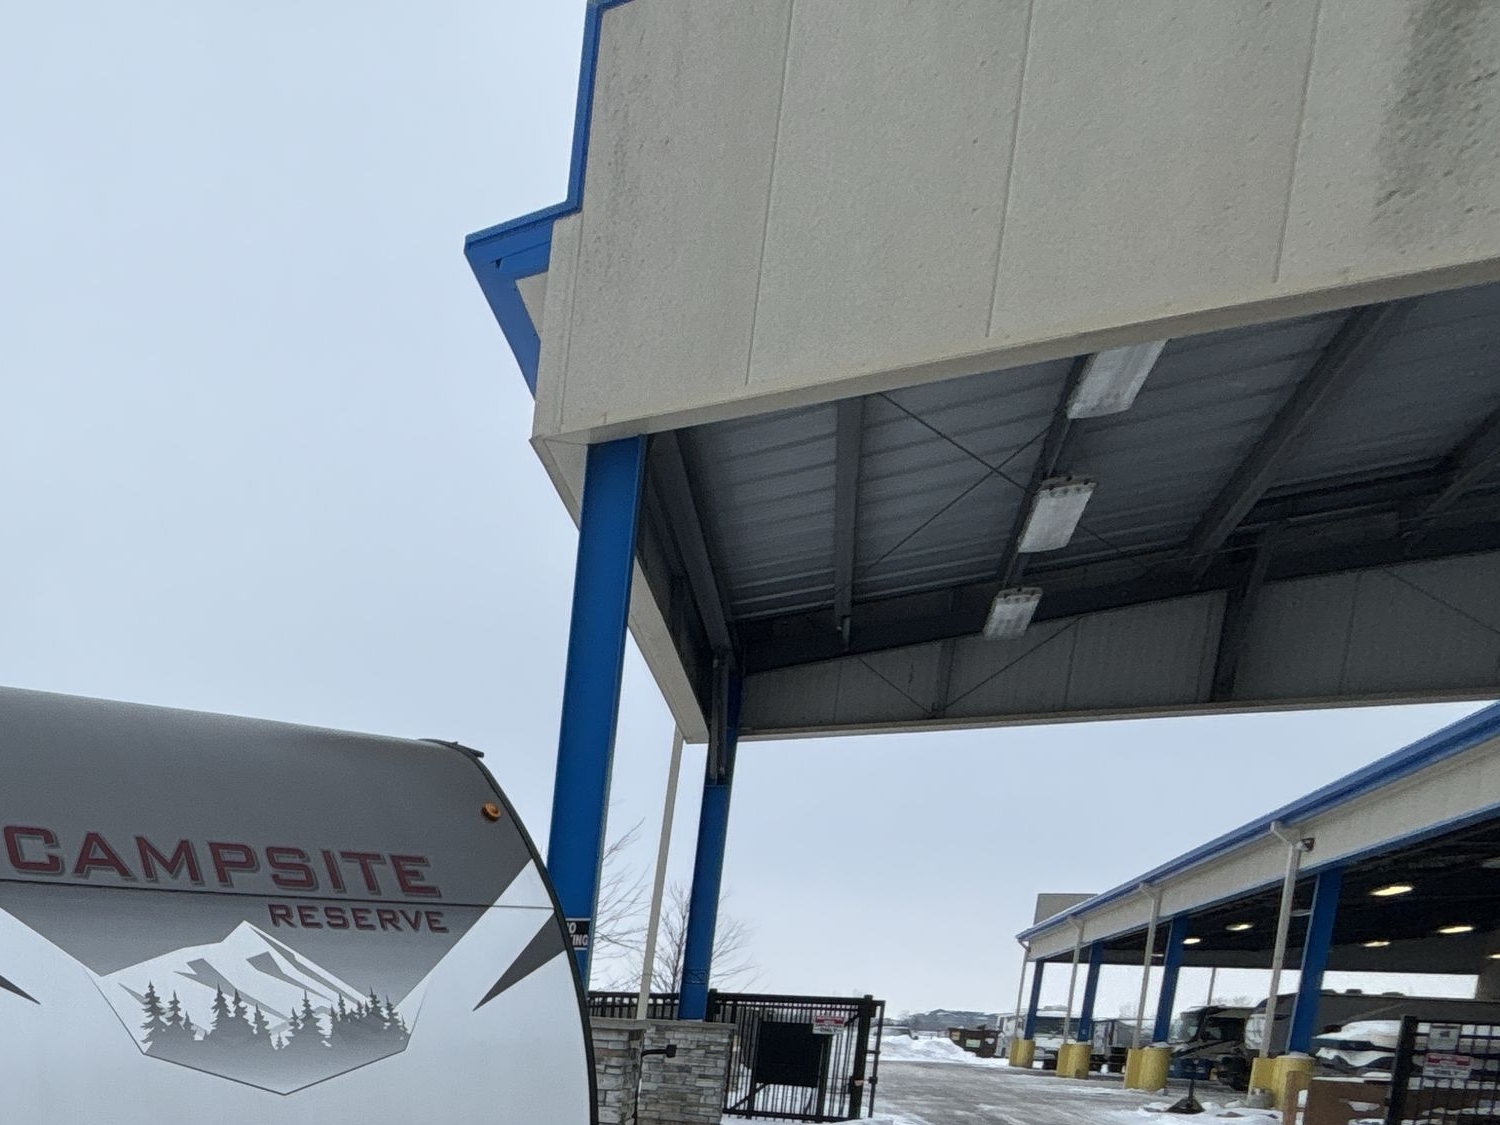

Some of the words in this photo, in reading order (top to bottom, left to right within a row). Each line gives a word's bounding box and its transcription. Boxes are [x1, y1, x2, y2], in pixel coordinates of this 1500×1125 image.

[2, 825, 442, 898] CAMPSITE
[267, 904, 450, 934] RESERVE
[566, 922, 577, 934] O
